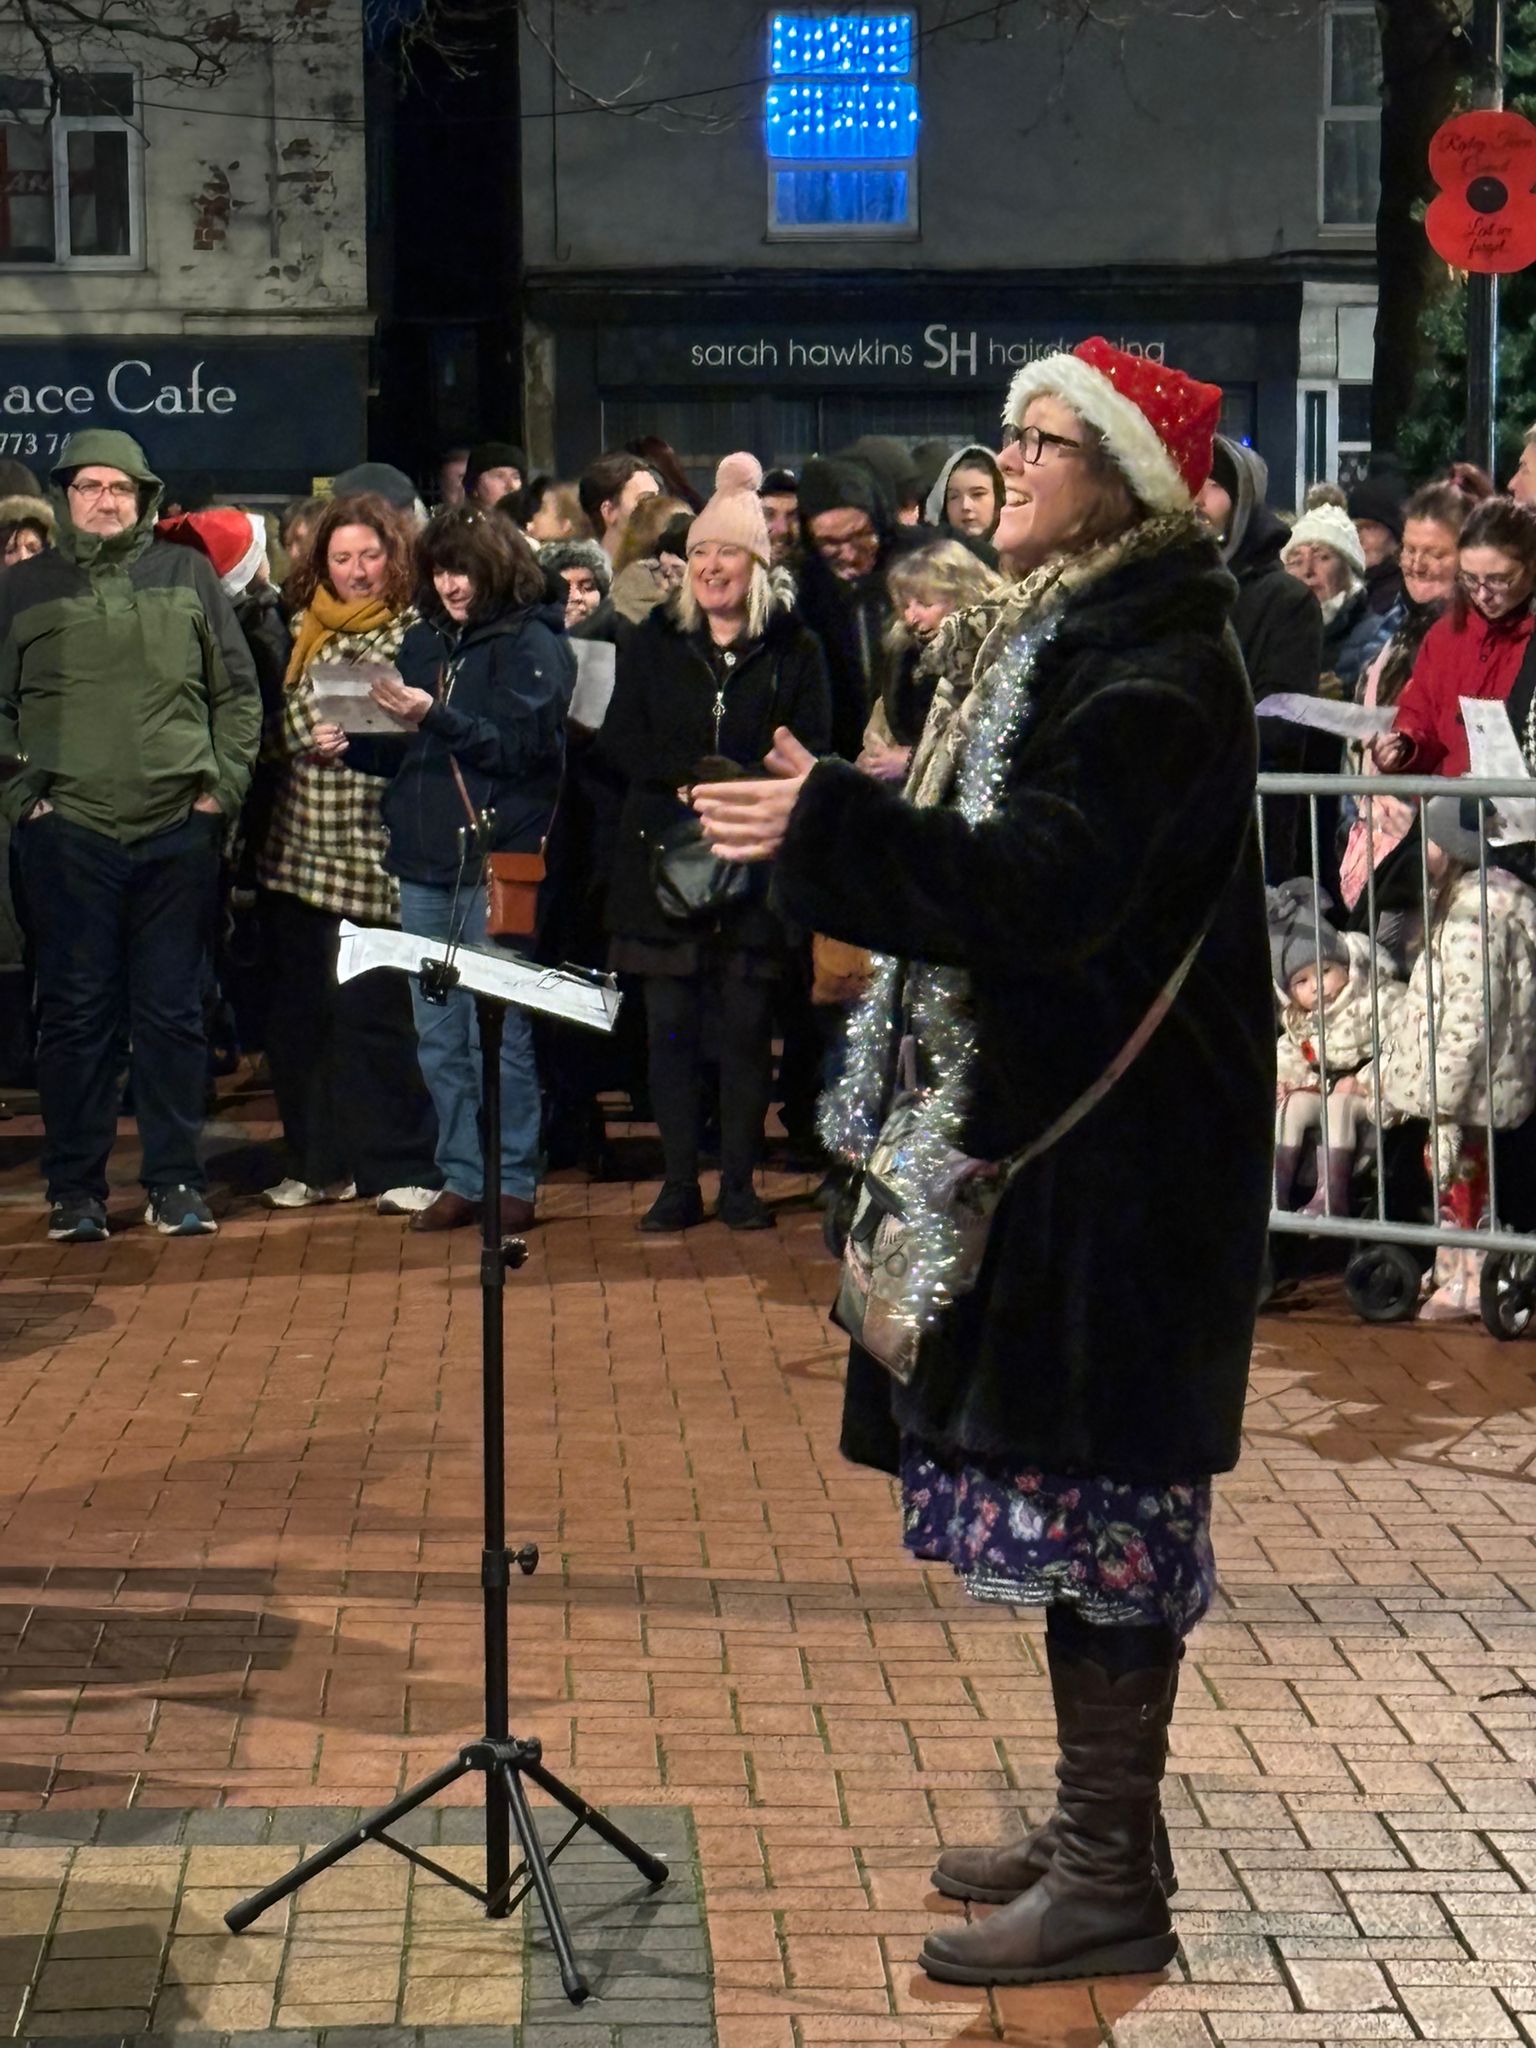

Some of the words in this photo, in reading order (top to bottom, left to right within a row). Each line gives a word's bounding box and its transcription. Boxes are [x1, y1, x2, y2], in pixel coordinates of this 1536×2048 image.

[691, 338, 777, 366] sarah
[789, 338, 913, 366] hawkins
[923, 323, 977, 376] SH
[0, 384, 95, 414] ace
[107, 360, 237, 415] Cafe
